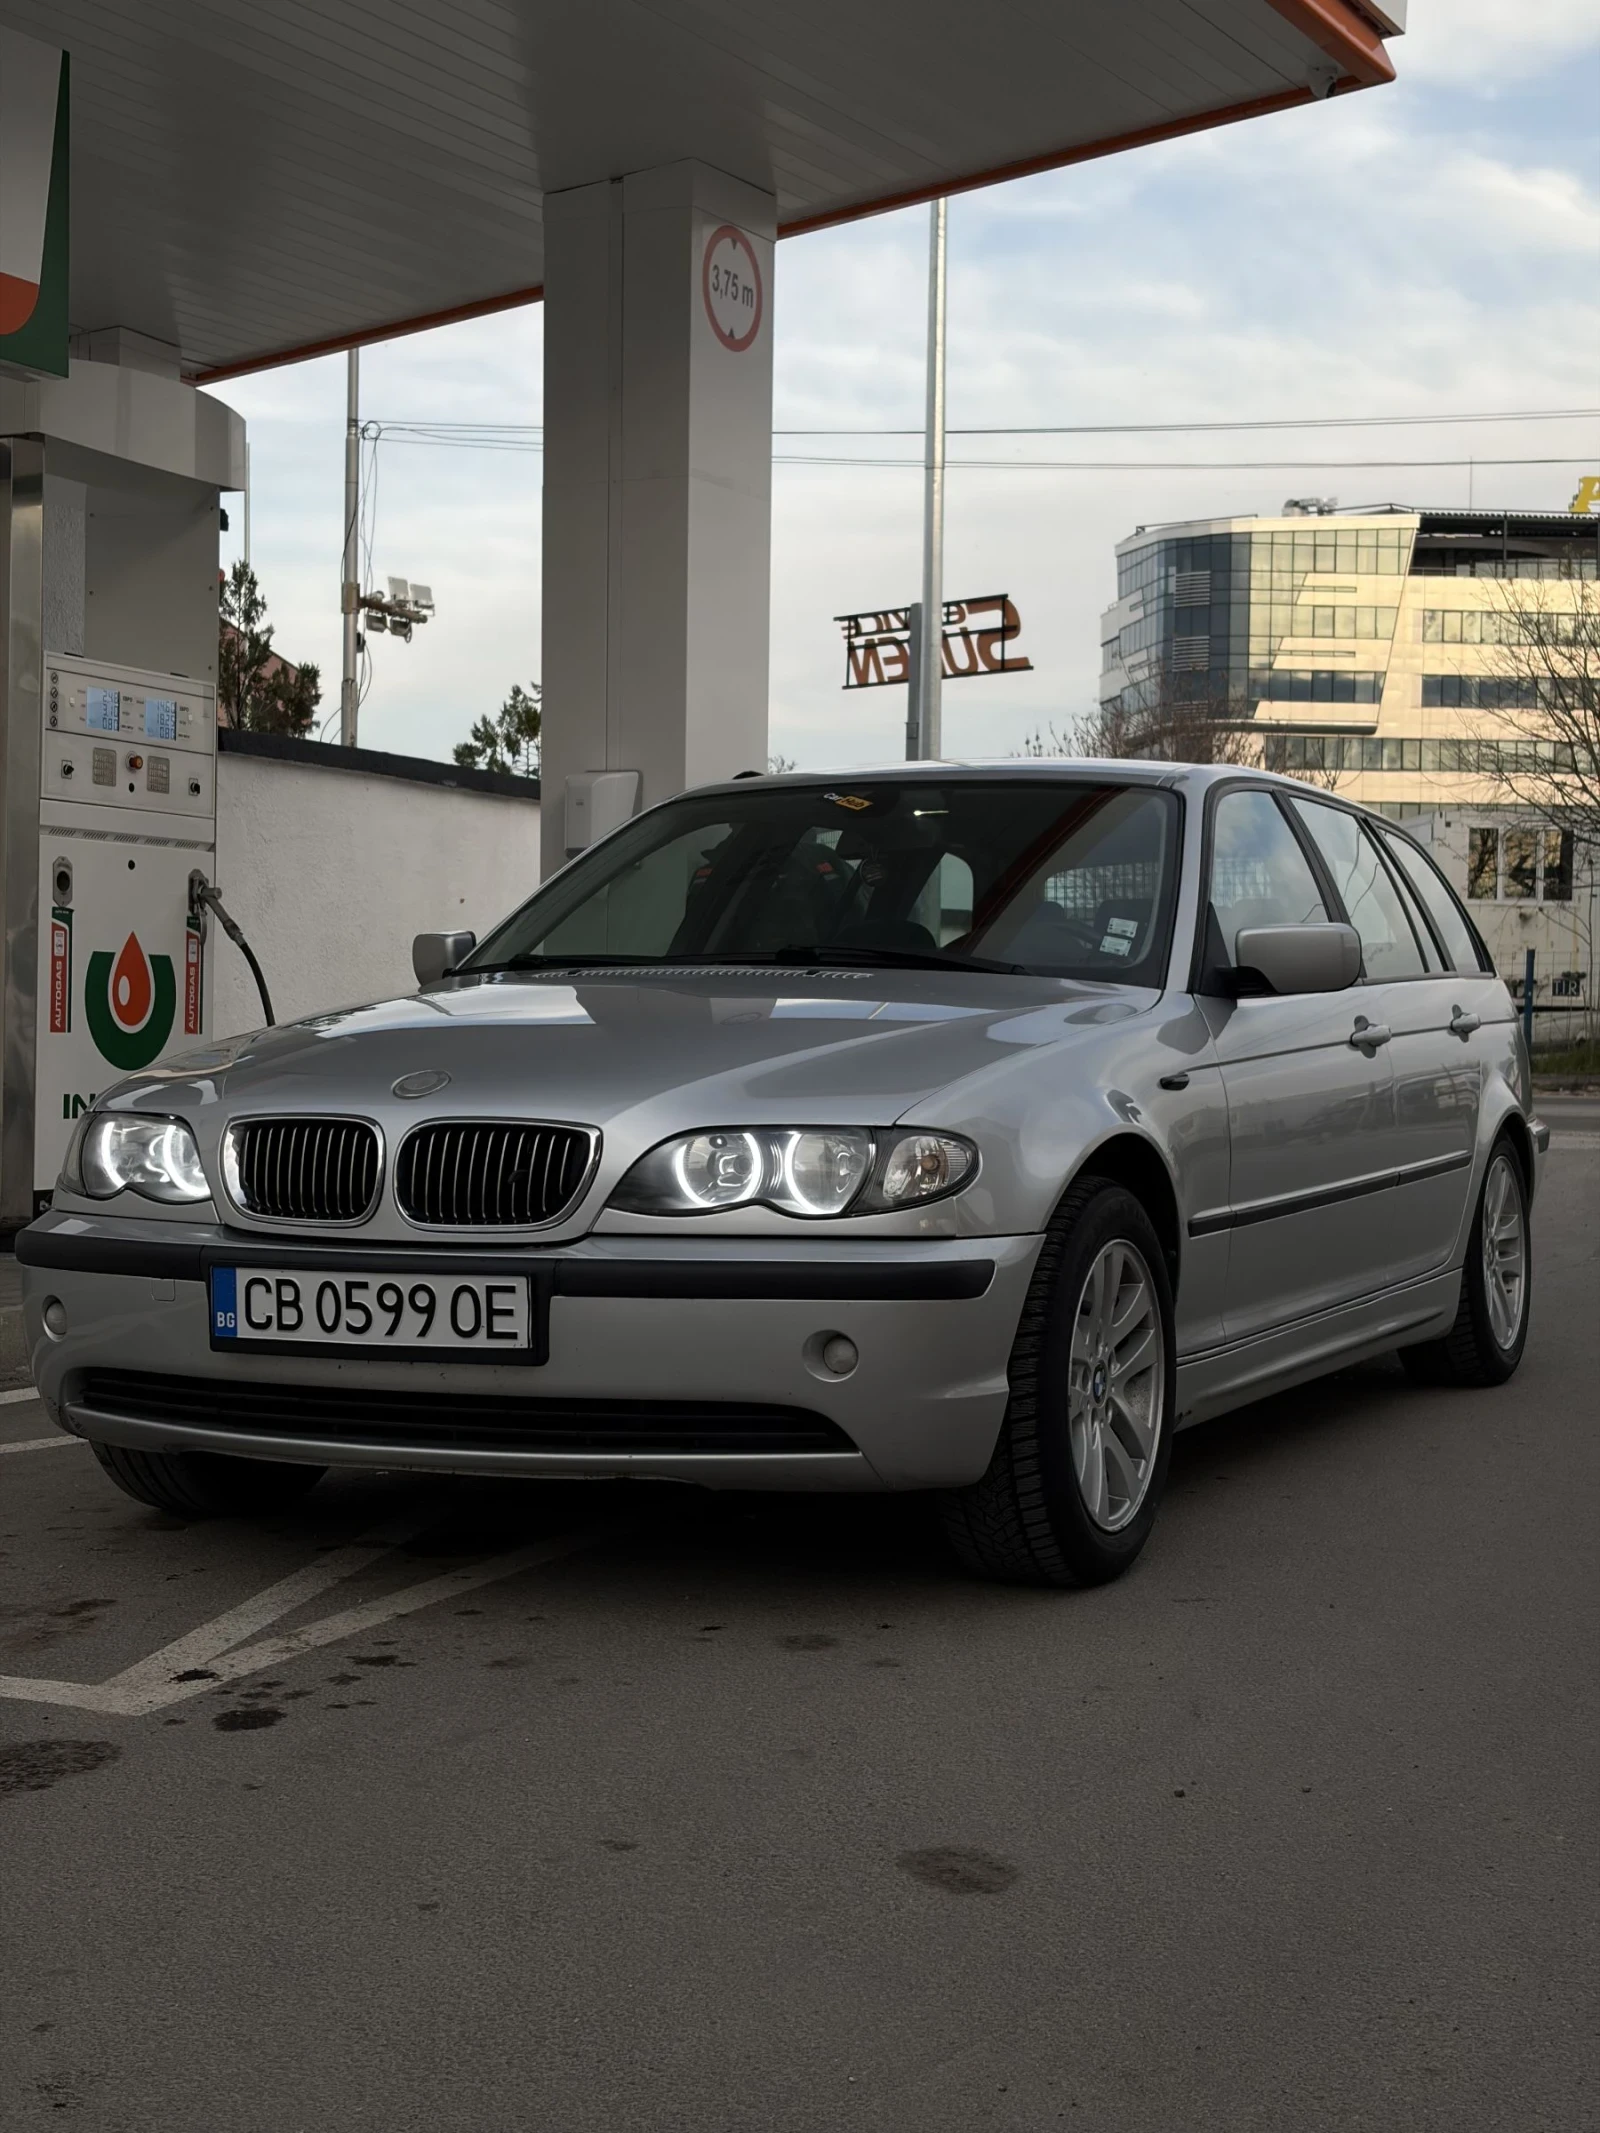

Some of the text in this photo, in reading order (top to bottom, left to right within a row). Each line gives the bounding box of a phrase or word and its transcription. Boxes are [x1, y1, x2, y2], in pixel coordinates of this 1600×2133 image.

[712, 264, 754, 309] 3,75 m
[188, 967, 196, 1029] AUTOGAS
[1553, 980, 1578, 996] TIR
[216, 1311, 236, 1328] BG
[244, 1276, 520, 1341] CB 0599 OE
